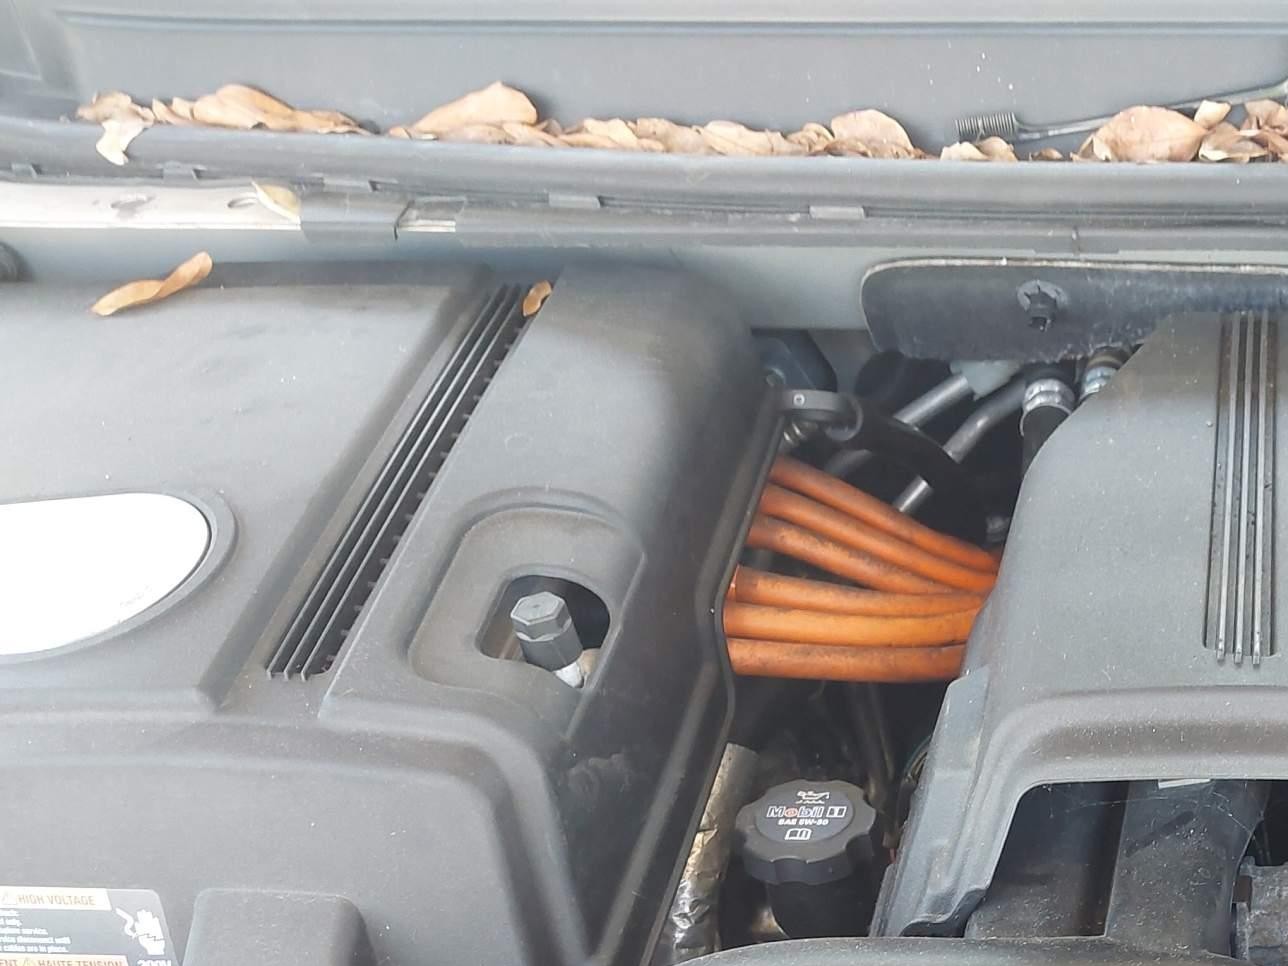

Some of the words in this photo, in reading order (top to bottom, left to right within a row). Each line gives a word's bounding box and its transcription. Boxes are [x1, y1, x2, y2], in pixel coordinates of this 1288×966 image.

[766, 805, 825, 818] Mobil
[778, 818, 797, 826] SAE
[18, 894, 45, 905] HIGH
[46, 895, 97, 906] VOLTAGE
